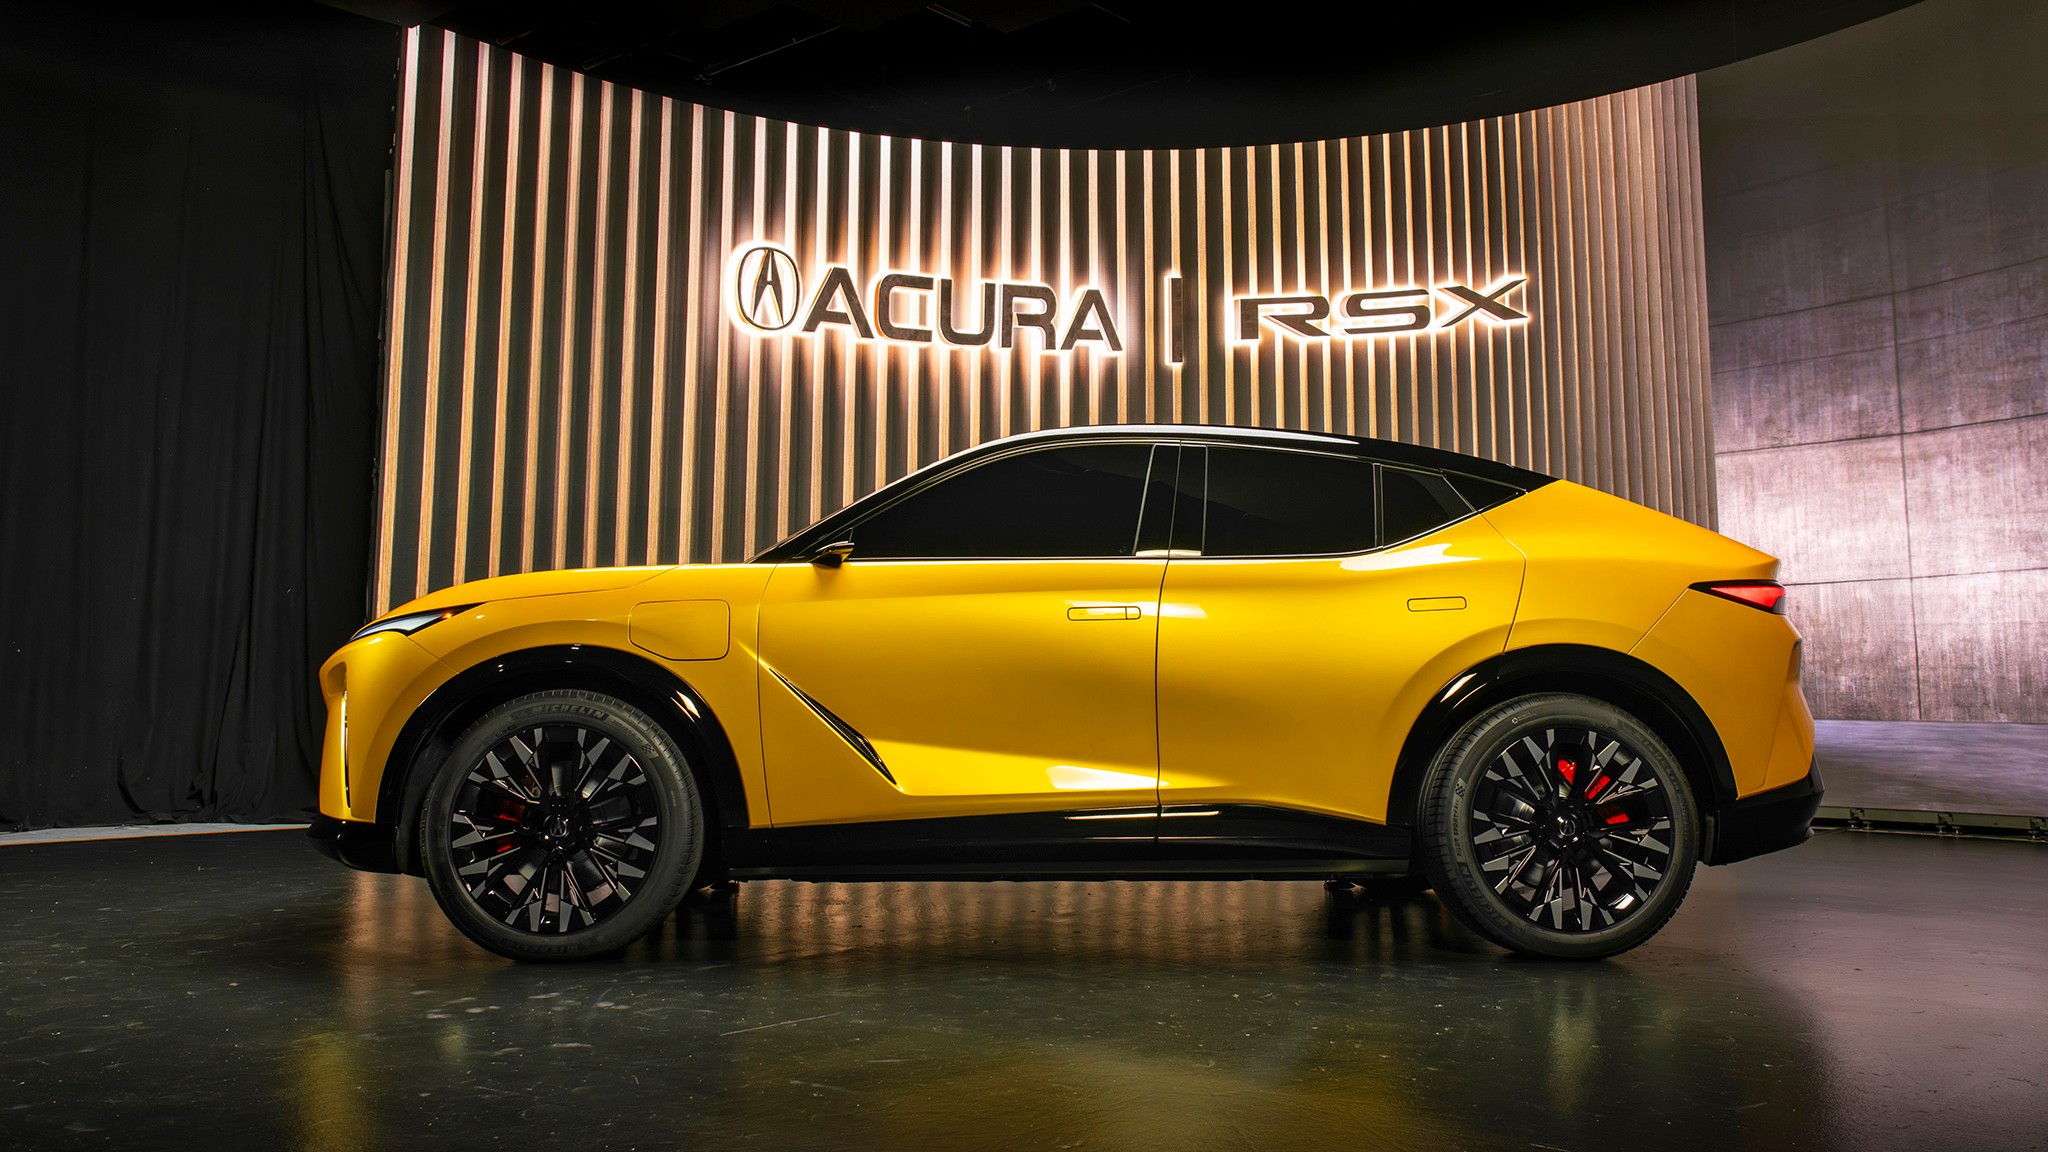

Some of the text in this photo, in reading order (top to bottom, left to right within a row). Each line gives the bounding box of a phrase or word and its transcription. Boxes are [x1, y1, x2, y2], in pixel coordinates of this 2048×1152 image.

[802, 266, 1123, 351] ACURA
[1236, 278, 1529, 340] RSX
[531, 704, 605, 719] MICHELIN
